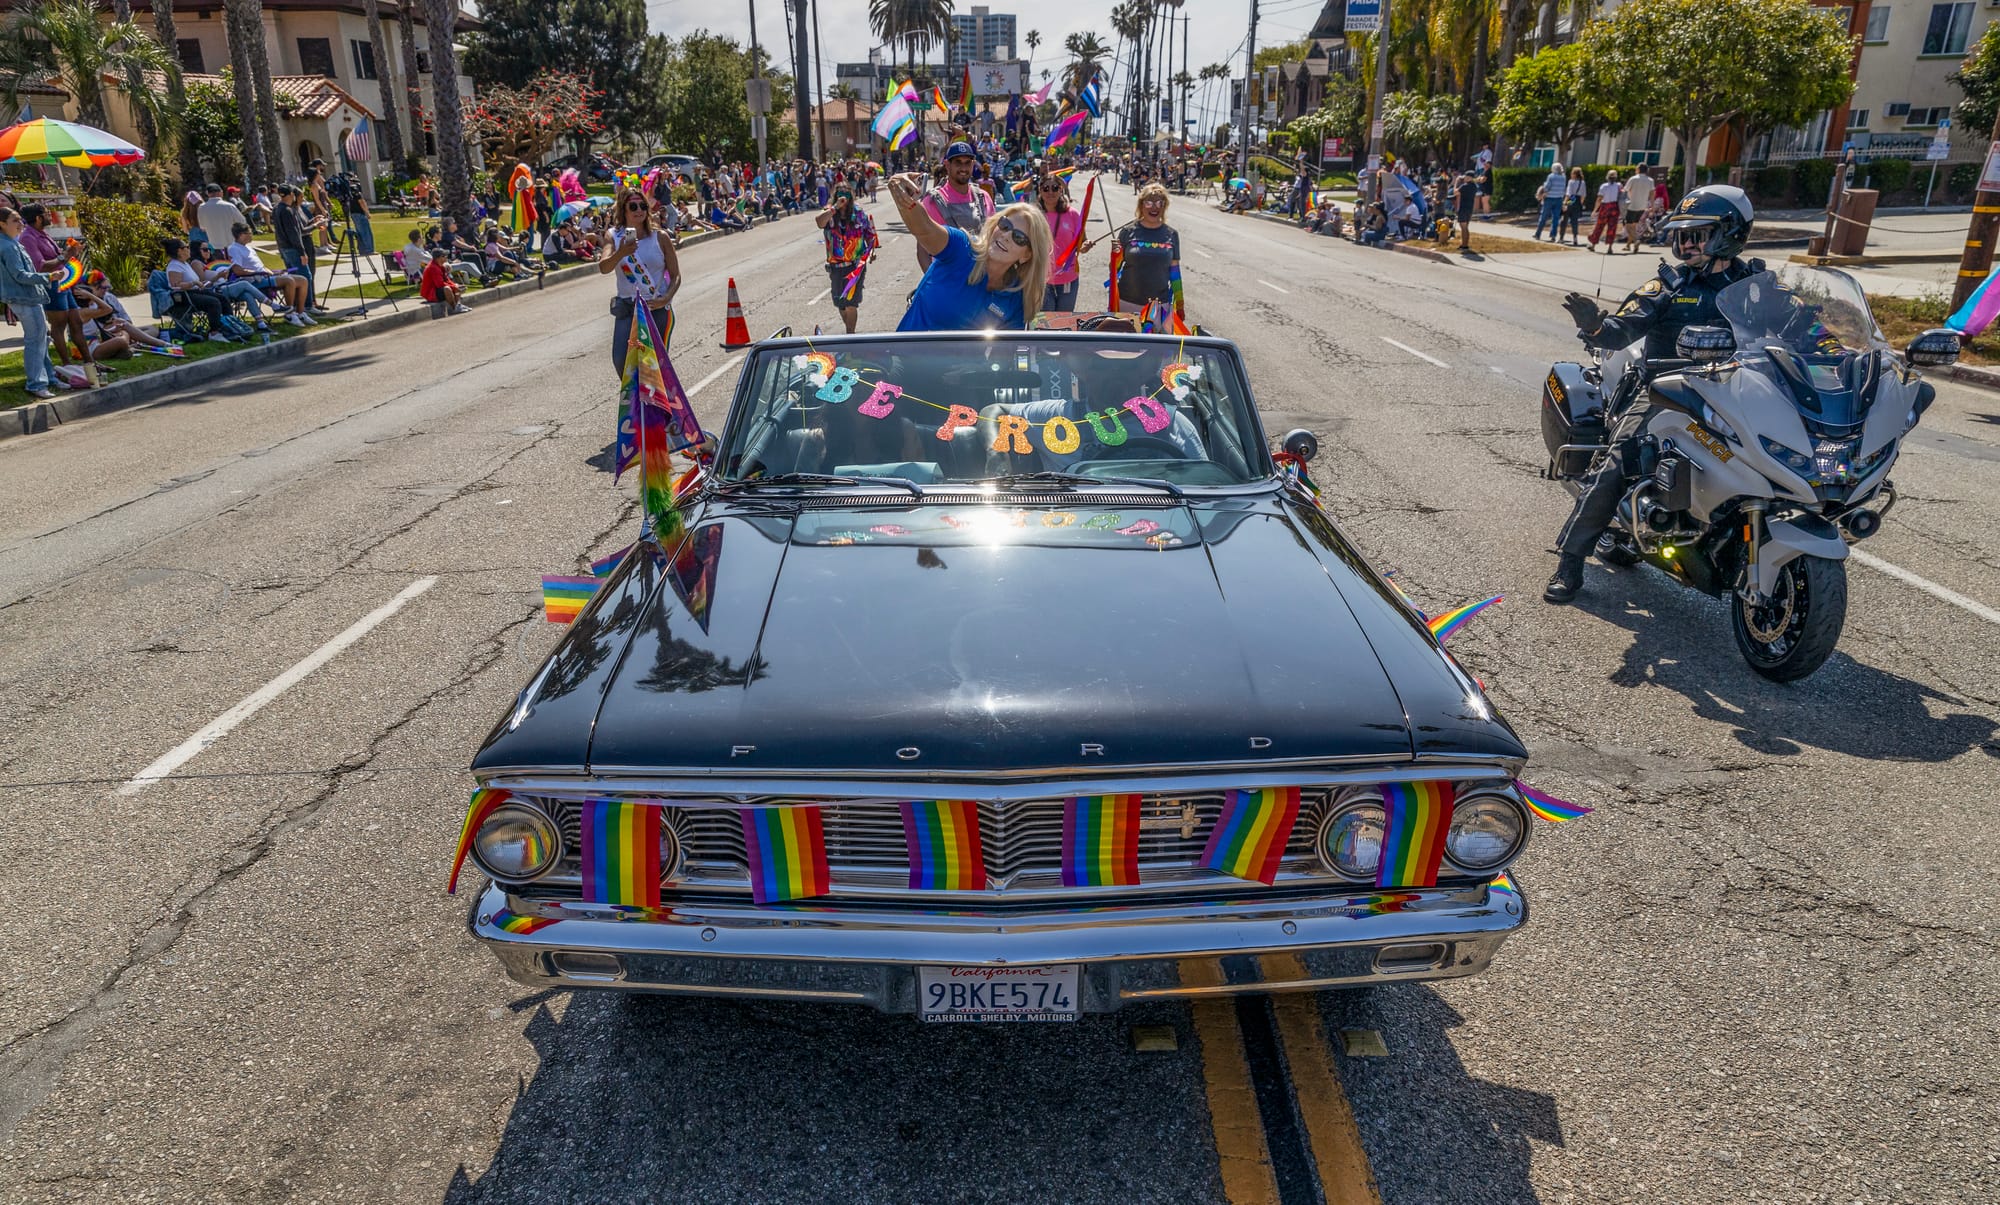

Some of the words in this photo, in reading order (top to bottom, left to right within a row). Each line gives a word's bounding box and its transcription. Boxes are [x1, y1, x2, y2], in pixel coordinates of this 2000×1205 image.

[1548, 374, 1565, 403] POLICE
[815, 366, 903, 419] BE
[935, 396, 1170, 455] PROUD
[1686, 422, 1736, 463] POLICE
[730, 736, 1273, 760] FORD
[951, 966, 1053, 980] California
[928, 982, 1070, 1008] 9BKE574
[927, 1014, 976, 1022] CARROLL
[980, 1014, 1021, 1022] SHELBY
[1027, 1013, 1073, 1022] MOTORS
